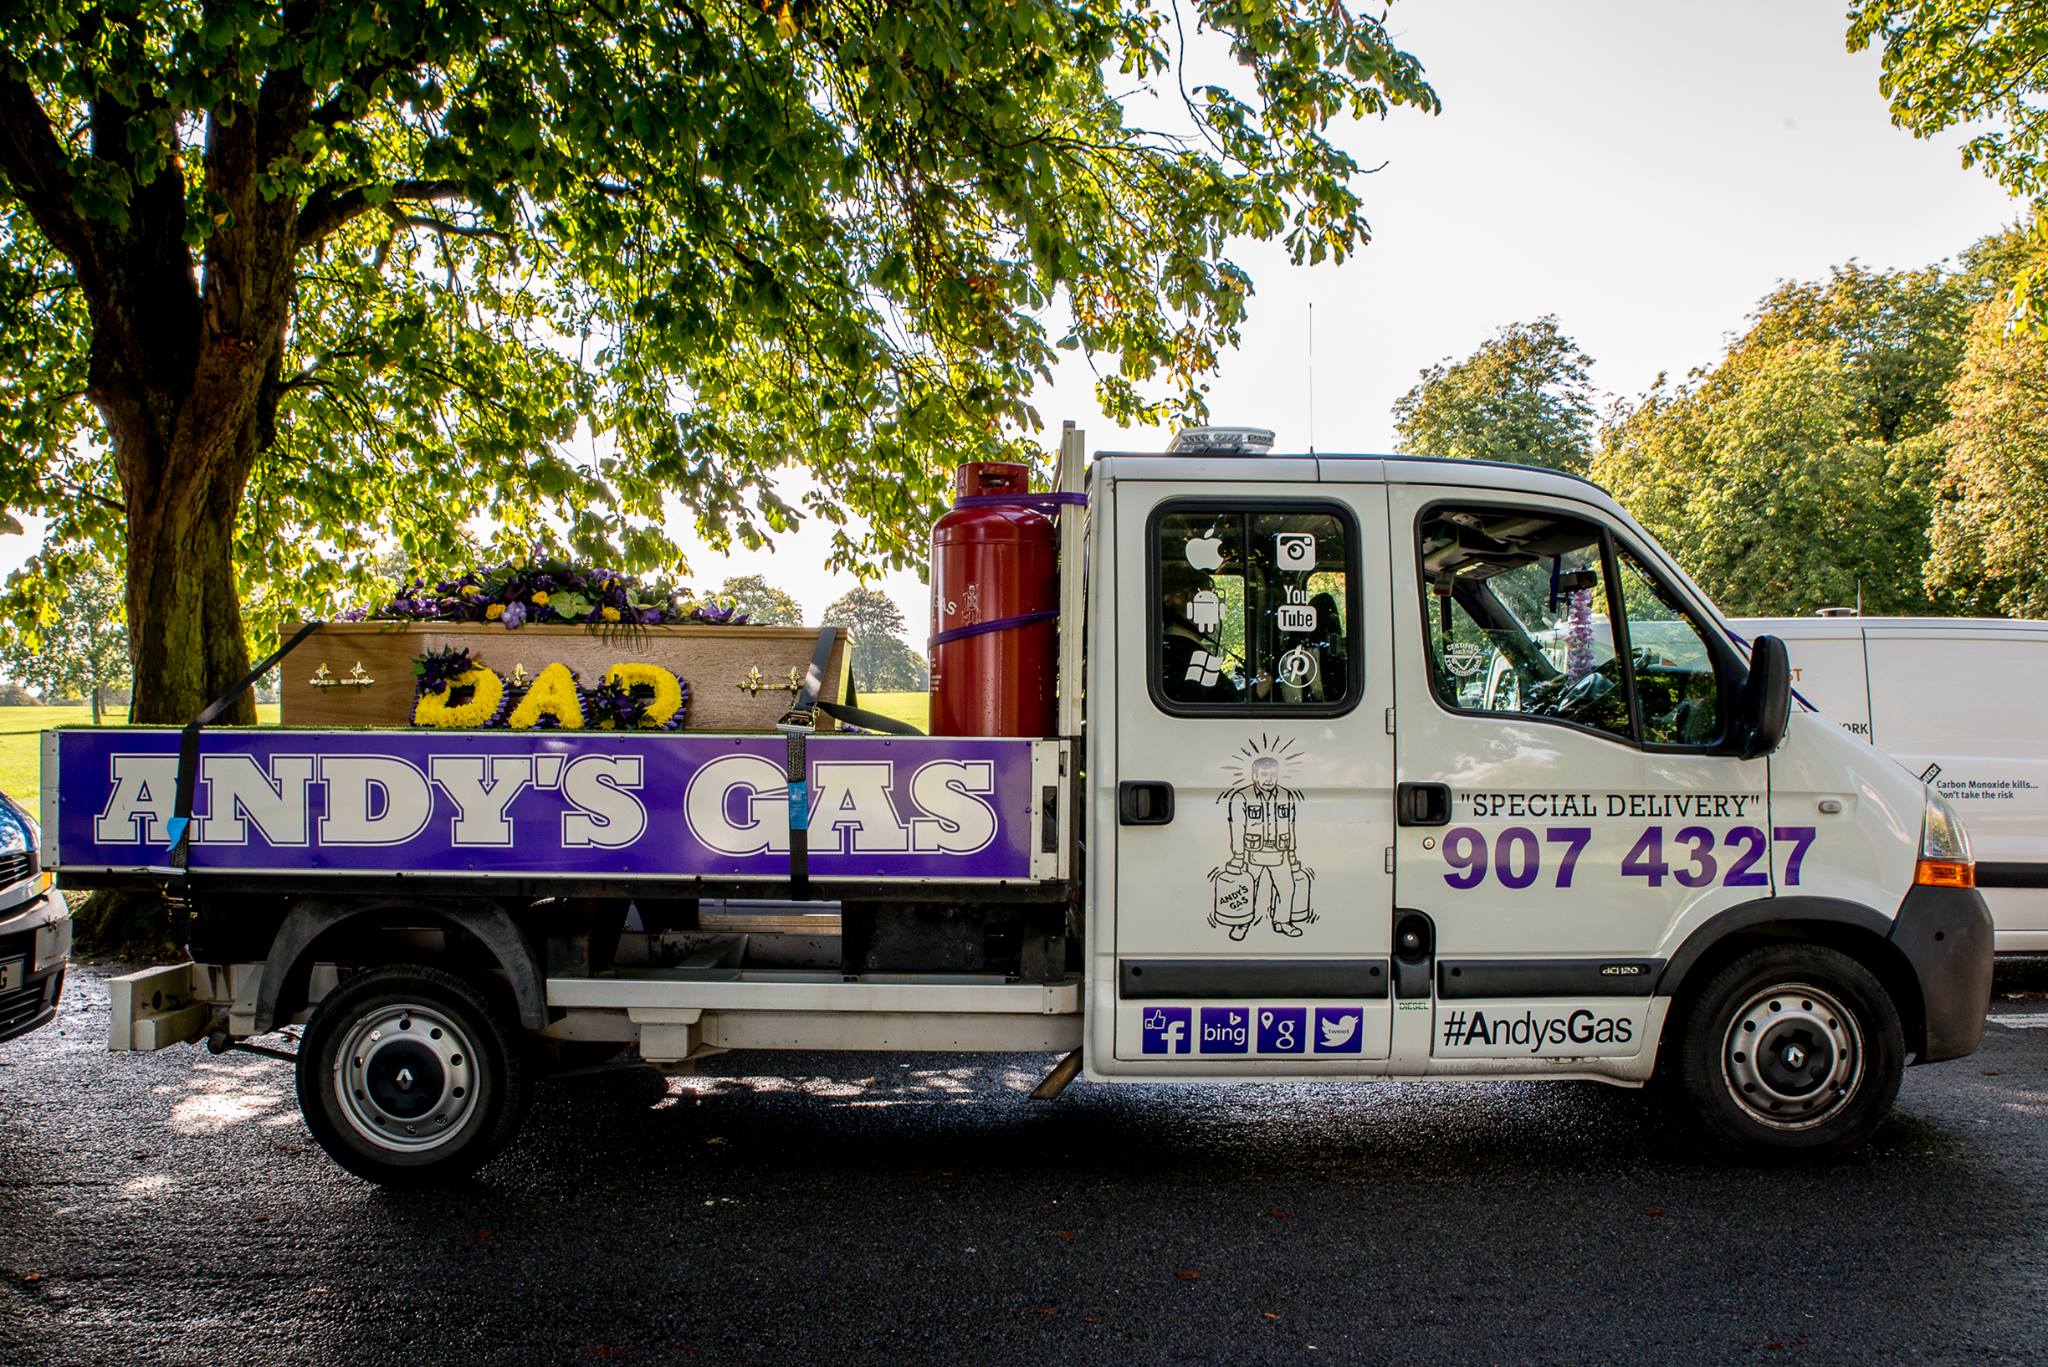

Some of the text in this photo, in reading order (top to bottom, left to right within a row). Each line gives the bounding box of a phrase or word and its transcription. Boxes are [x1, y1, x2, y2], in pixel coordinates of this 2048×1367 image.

[1283, 584, 1308, 605] You
[1280, 609, 1313, 627] Tube
[411, 658, 687, 729] DAD
[1936, 780, 2039, 789] Carbon Monoxide kills...
[1961, 791, 1980, 799] take
[1981, 791, 1996, 799] the
[1997, 791, 2014, 799] risk
[93, 752, 998, 858] ANDY'S GAS
[1460, 793, 1760, 818] "SPECIAL DELIVERY"
[1442, 826, 1817, 890] 907 4327
[1219, 884, 1249, 905] ANDY'S
[1229, 895, 1249, 910] GAS
[1399, 1002, 1429, 1010] DIESEL
[1204, 1023, 1246, 1046] bing
[1443, 1009, 1633, 1053] #AndysGas
